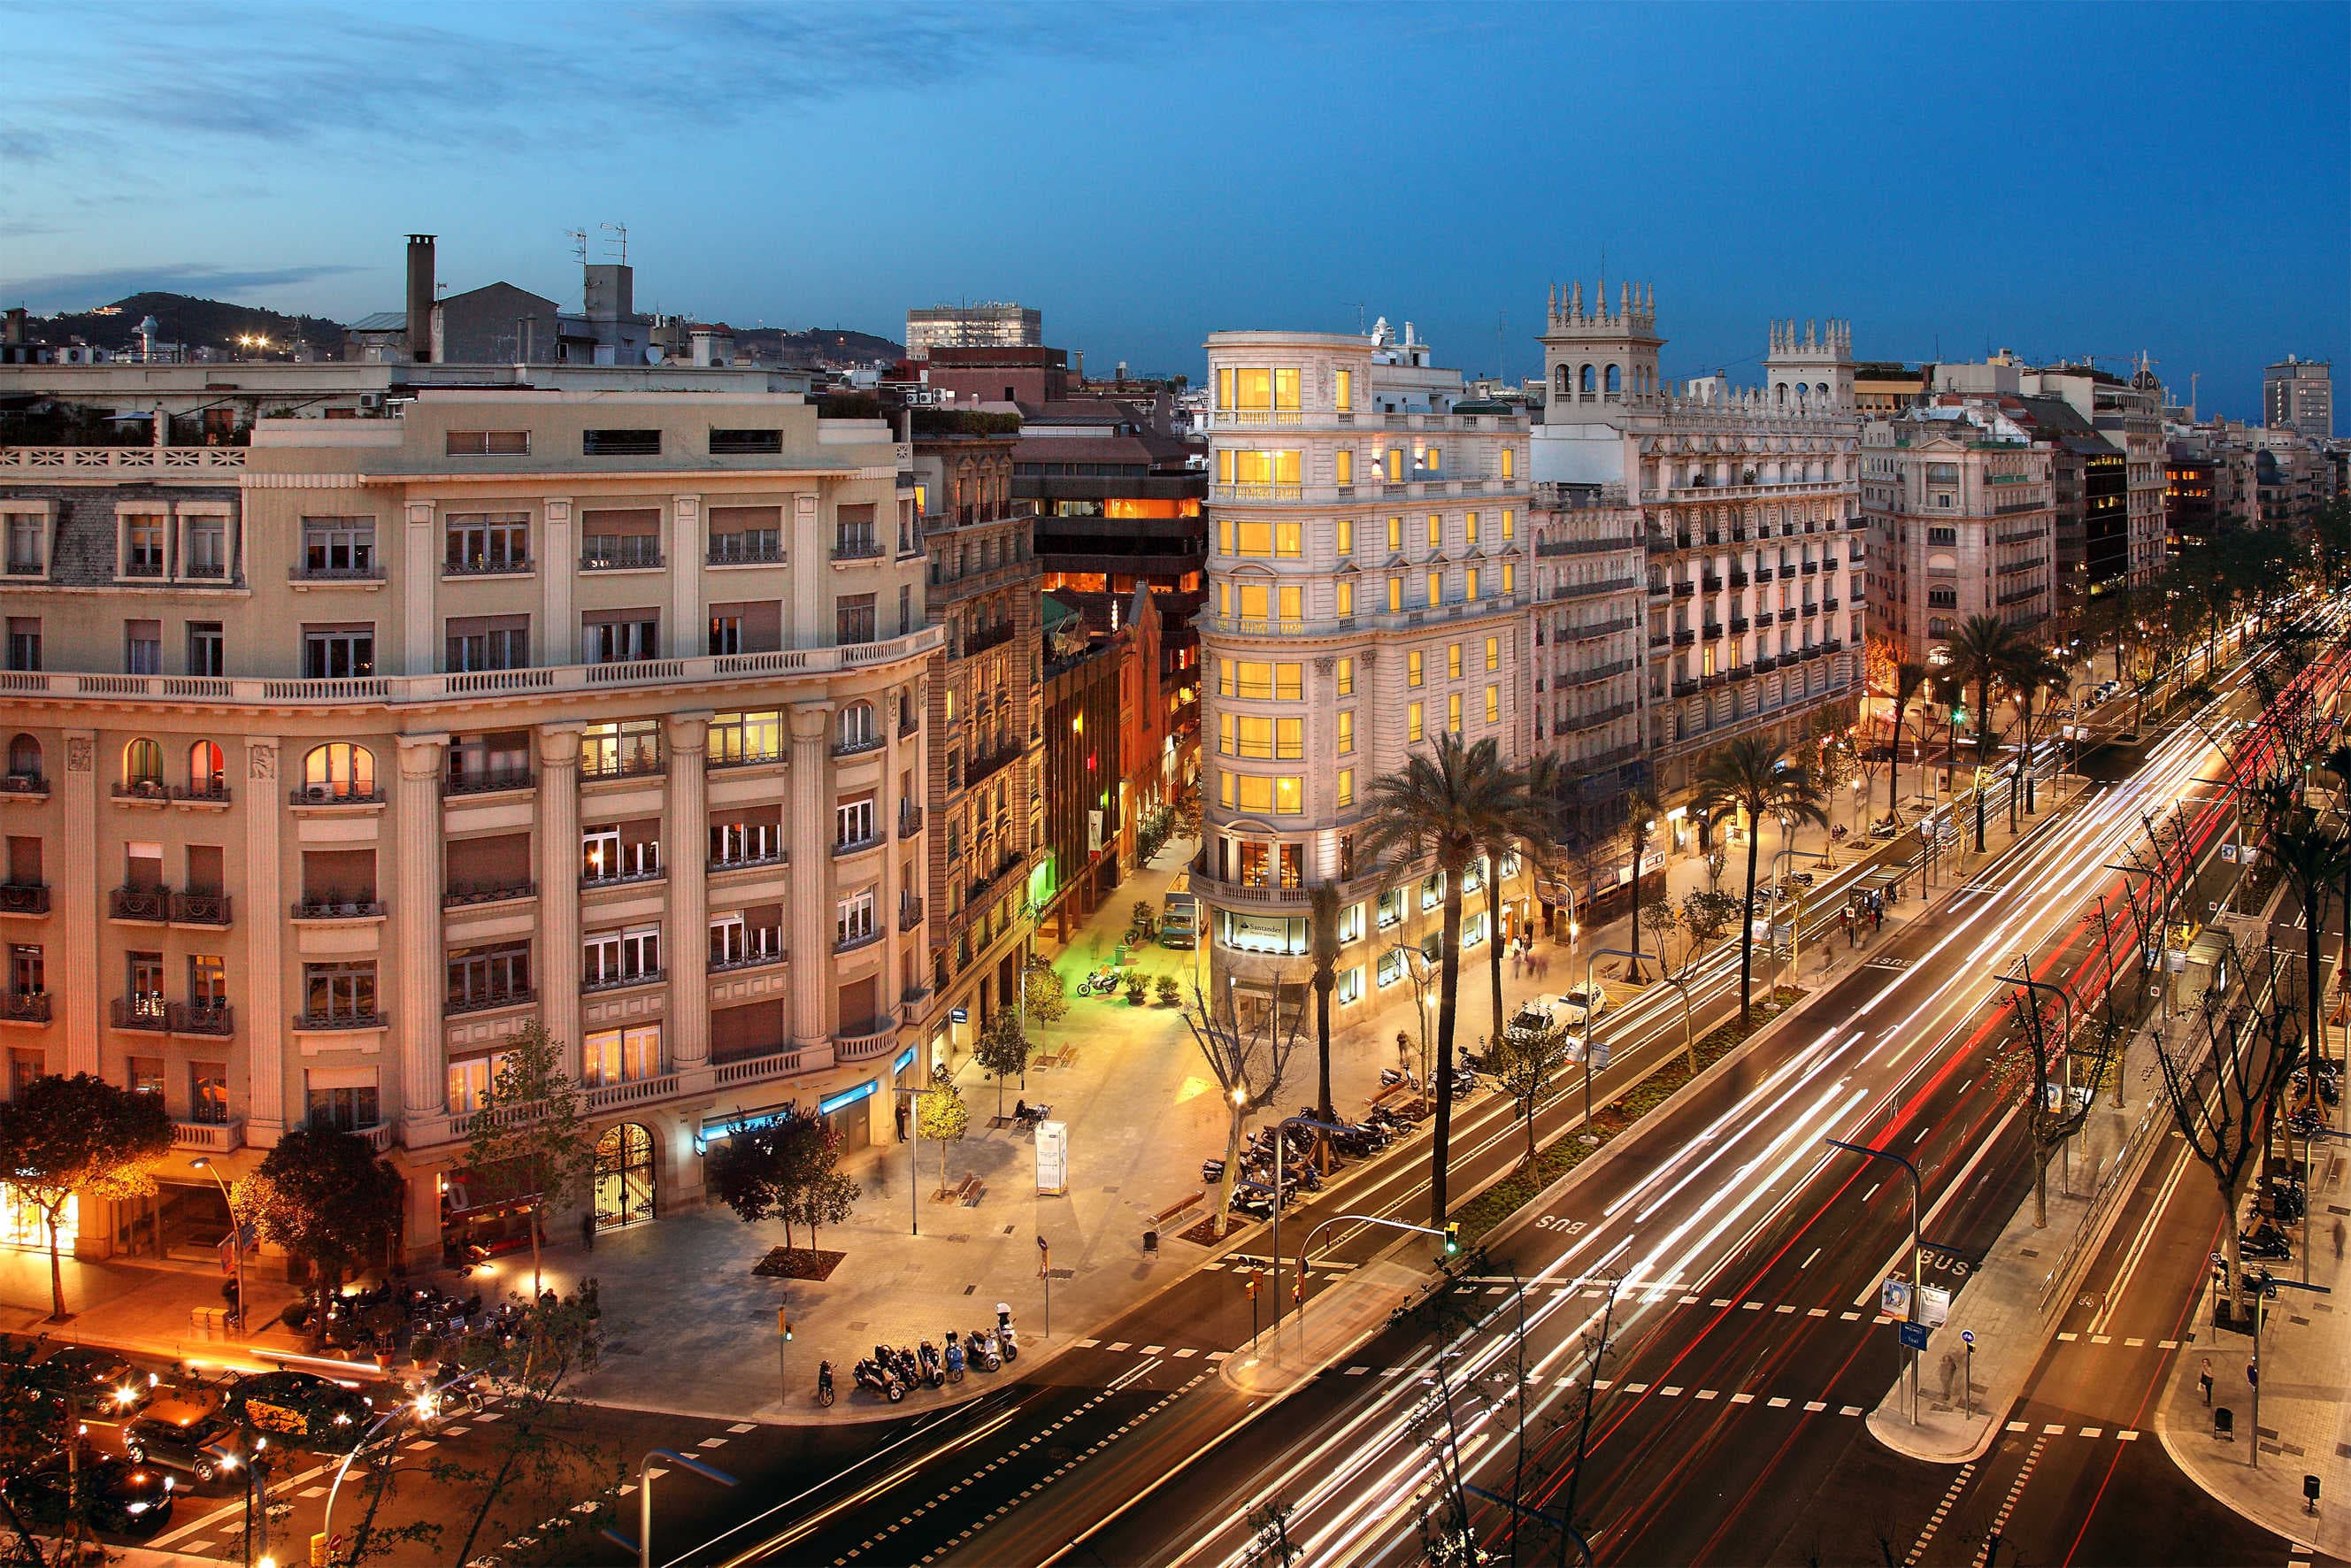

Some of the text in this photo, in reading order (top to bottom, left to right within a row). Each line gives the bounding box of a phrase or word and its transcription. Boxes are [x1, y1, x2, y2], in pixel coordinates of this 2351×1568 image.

[1249, 923, 1281, 934] Santander
[1879, 957, 1914, 967] BUS
[1535, 1215, 1588, 1235] BUS
[1920, 1249, 1969, 1276] BUS
